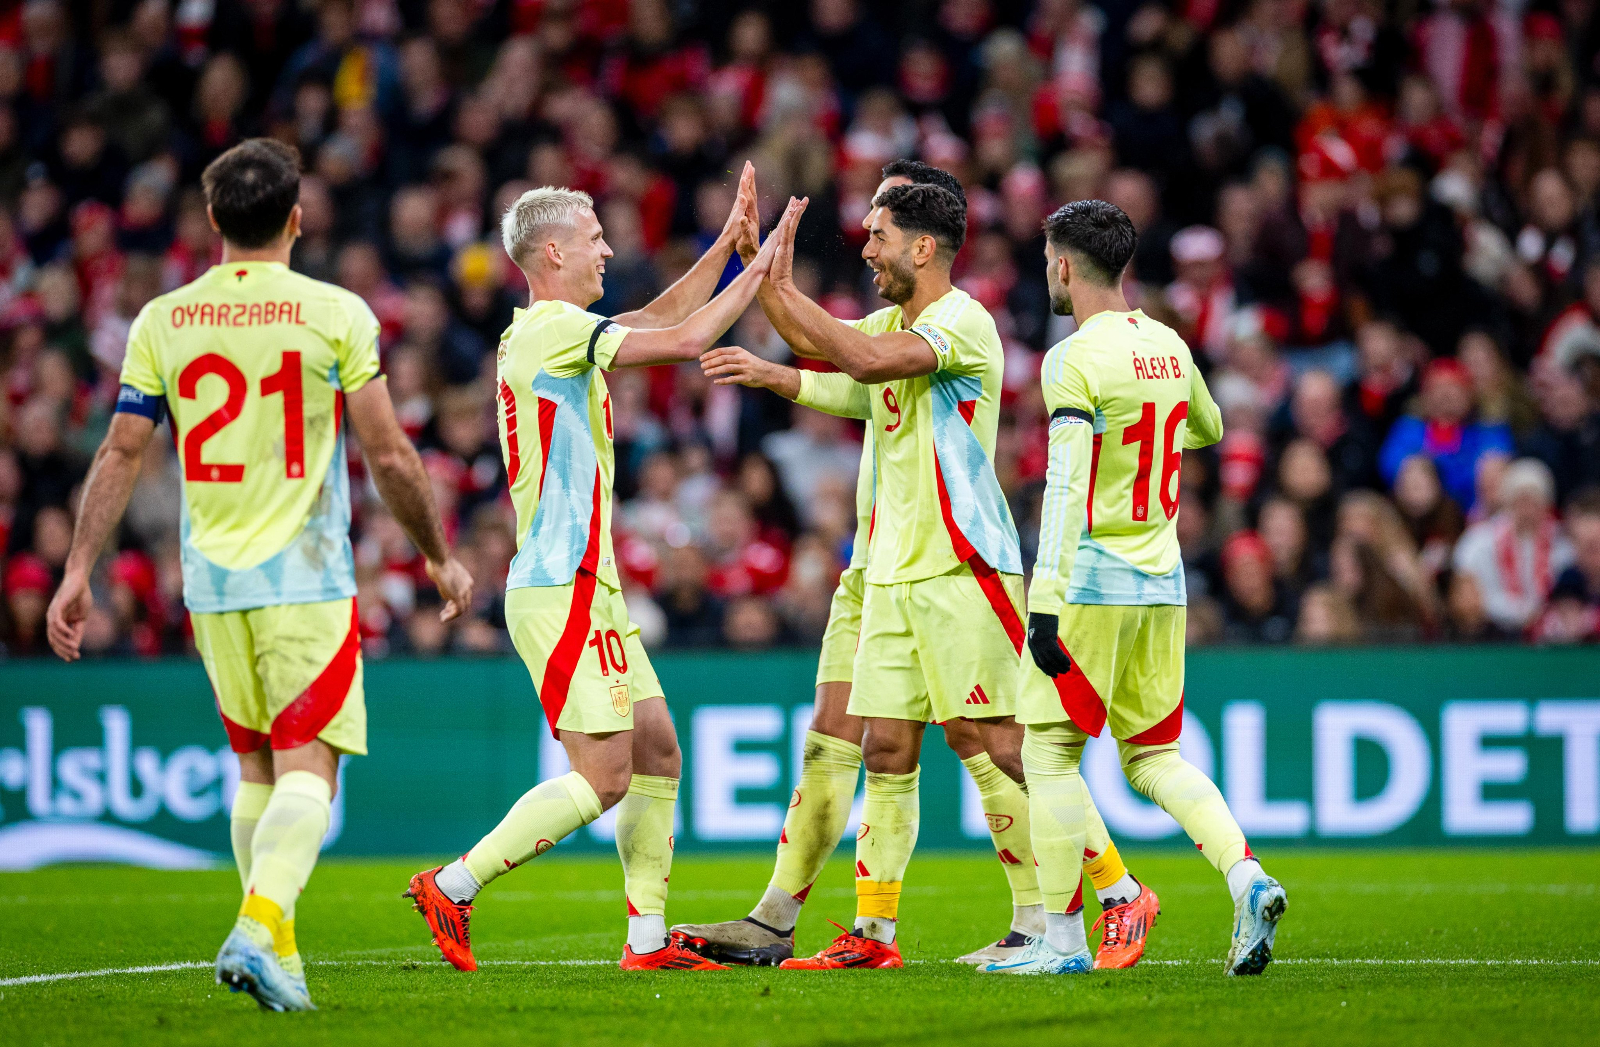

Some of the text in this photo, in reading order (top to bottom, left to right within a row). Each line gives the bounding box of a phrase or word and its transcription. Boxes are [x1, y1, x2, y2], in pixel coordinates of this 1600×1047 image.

[171, 301, 307, 328] OYARZABAL
[1170, 356, 1185, 379] B.
[178, 351, 305, 482] 21
[883, 387, 901, 432] 9
[1122, 401, 1188, 521] 16
[588, 629, 628, 677] 10
[960, 699, 1600, 838] OLDET
